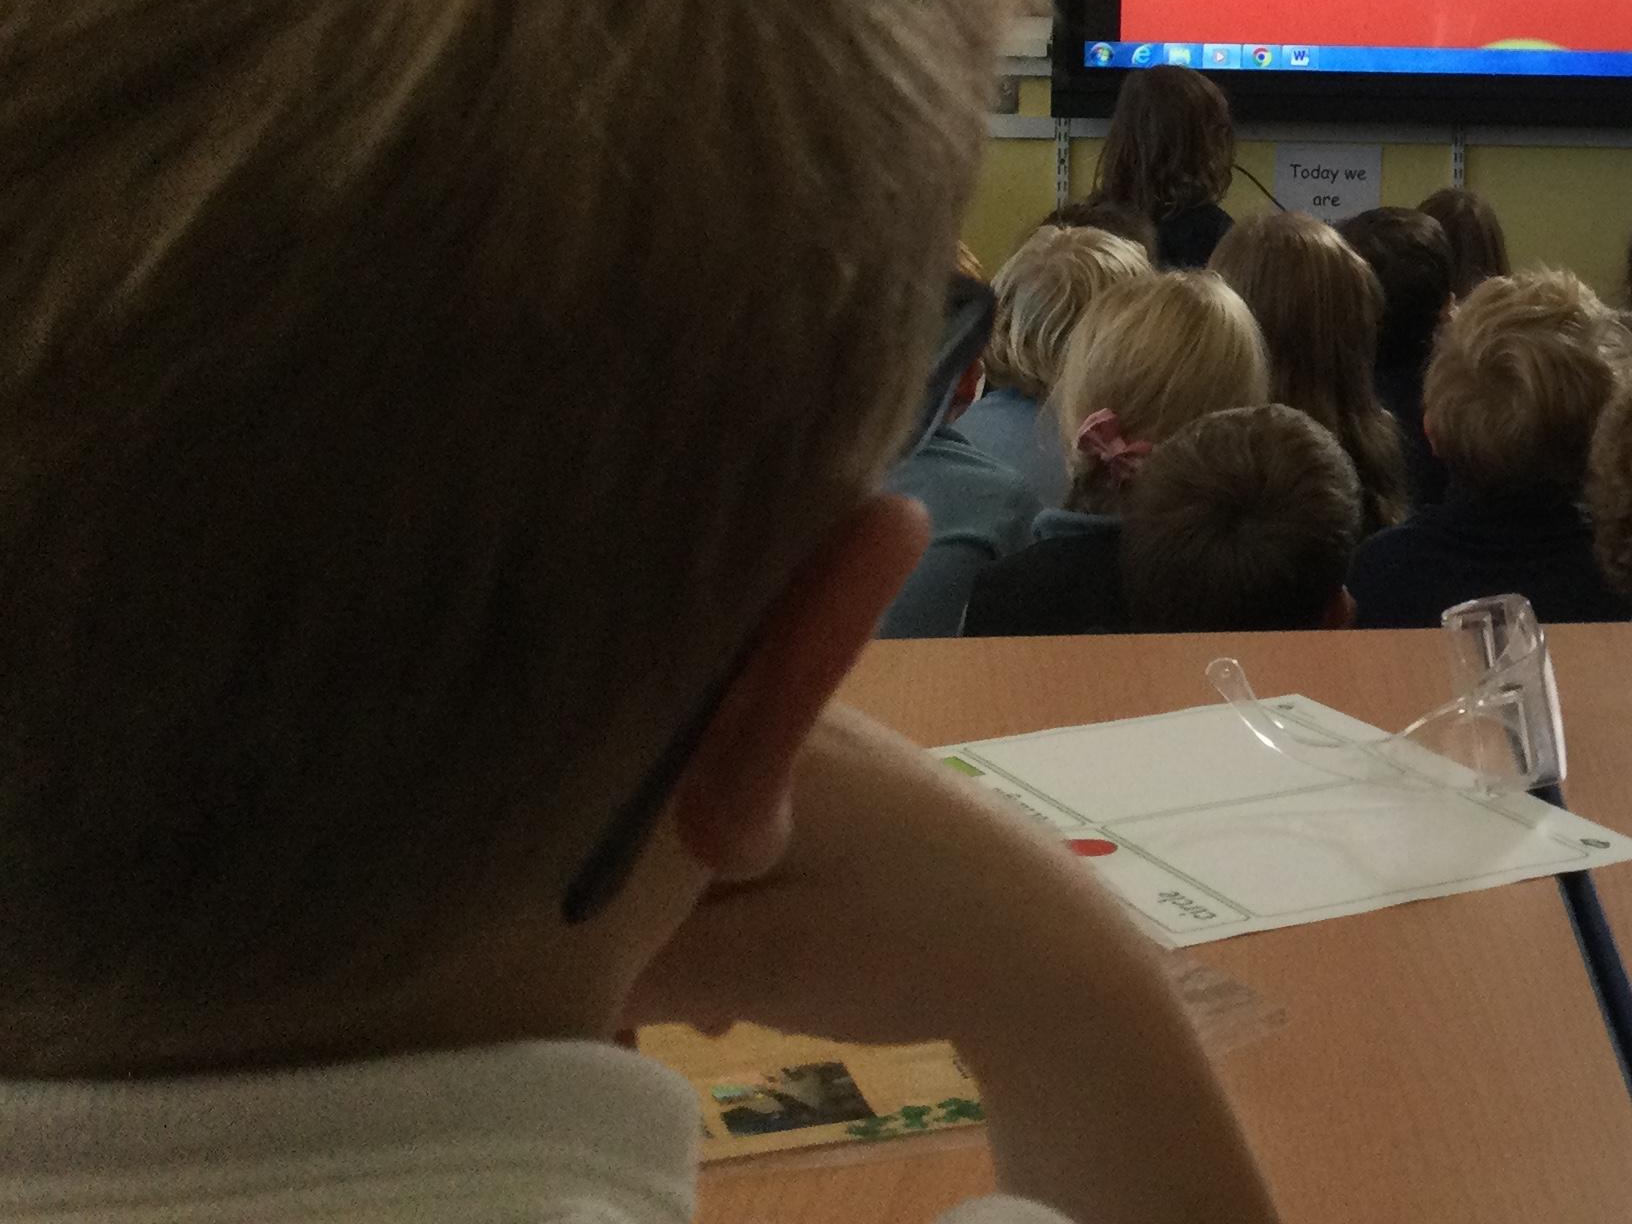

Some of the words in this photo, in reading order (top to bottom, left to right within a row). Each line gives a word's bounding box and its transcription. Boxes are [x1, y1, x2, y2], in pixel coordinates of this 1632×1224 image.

[1290, 163, 1339, 184] Today
[1344, 167, 1367, 181] we
[1313, 192, 1341, 208] are
